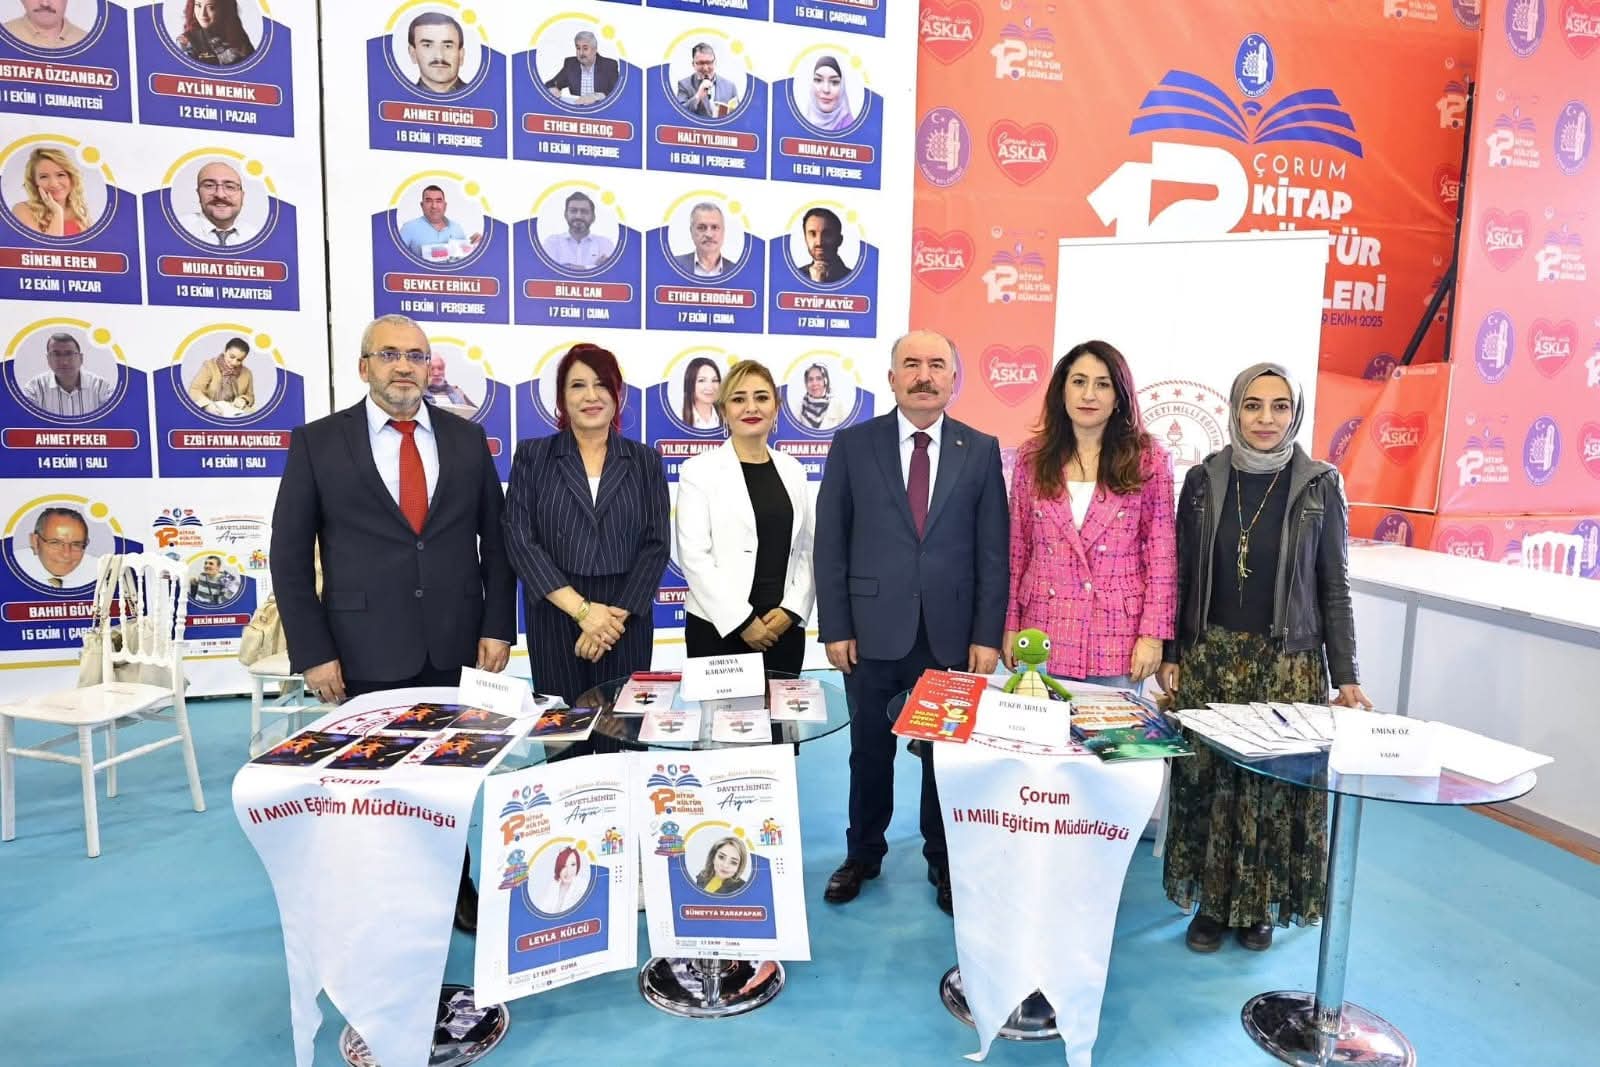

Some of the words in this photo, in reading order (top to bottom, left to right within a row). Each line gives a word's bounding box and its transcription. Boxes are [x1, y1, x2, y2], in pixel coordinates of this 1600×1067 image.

[808, 7, 823, 20] EKİM
[829, 12, 867, 26] ÇARŞAMBA
[990, 39, 1029, 80] 12
[46, 65, 112, 86] ÖZCANBAZ
[177, 79, 212, 95] AYLİN
[215, 82, 255, 100] MEMİK
[10, 88, 36, 104] EKİM
[45, 93, 103, 110] CUMARTESİ
[180, 106, 191, 118] 12
[193, 104, 217, 121] EKİM
[226, 109, 256, 123] PAZAR
[404, 107, 441, 122] AHMET
[441, 108, 474, 126] BİÇİCİ
[543, 119, 577, 133] ETHEM
[579, 122, 613, 138] ERKOÇ
[409, 129, 430, 144] EKİM
[438, 133, 482, 148] PERŞEMBE
[550, 140, 570, 155] EKİM
[577, 144, 619, 159] PERŞEMBE
[681, 151, 700, 165] EKİM
[706, 155, 745, 169] PERŞEMBE
[1253, 152, 1347, 180] ÇORUM
[803, 162, 820, 176] EKİM
[826, 166, 861, 180] PERŞEMBE
[1252, 177, 1353, 220] KİTAP
[22, 251, 63, 267] SİNEM
[64, 254, 96, 269] EREN
[183, 262, 222, 276] MURAT
[224, 261, 265, 277] GÜVEN
[20, 277, 32, 289] 12
[34, 276, 59, 291] EKİM
[69, 279, 101, 292] PAZAR
[177, 284, 188, 296] 13
[191, 282, 214, 298] EKİM
[222, 285, 272, 301] PAZARTESİ
[404, 279, 444, 293] ŞEVKET
[446, 278, 480, 293] ERİKLİ
[555, 282, 581, 297] BİLAL
[583, 287, 602, 298] CAN
[981, 265, 1019, 304] 12
[668, 291, 699, 303] ETHEM
[700, 291, 744, 305] ERDOĞAN
[794, 295, 821, 309] EYYÜP
[823, 297, 853, 310] AKYÜZ
[413, 299, 434, 313] EKİM
[441, 303, 485, 316] PERŞEMBE
[549, 307, 558, 317] 17
[560, 305, 579, 318] EKİM
[587, 309, 609, 320] CUMA
[678, 312, 688, 322] 17
[689, 310, 707, 323] EKİM
[713, 314, 734, 324] CUMA
[798, 317, 807, 327] 17
[808, 316, 825, 329] EKİM
[830, 318, 849, 329] CUMA
[1330, 311, 1358, 327] EKİM
[1360, 314, 1384, 328] 2025
[1173, 405, 1200, 417] MİLLİ
[35, 434, 71, 446] AHMET
[73, 434, 107, 446] PEKER
[183, 431, 206, 446] EZGİ
[207, 434, 238, 446] FATMA
[240, 432, 282, 448] AÇIKGÖZ
[38, 457, 51, 468] 14
[53, 454, 77, 469] EKİM
[85, 457, 107, 468] SALI
[201, 457, 214, 468] 14
[215, 454, 238, 469] EKİM
[246, 457, 266, 468] SALI
[29, 601, 68, 617] BAHRİ
[22, 629, 34, 640] 15
[35, 626, 61, 640] EKİM
[320, 775, 380, 787] Çorum
[1019, 785, 1070, 806] Çorum
[248, 806, 262, 825] İl
[263, 795, 303, 823] Milli
[304, 796, 346, 817] Eğitim
[351, 797, 456, 829] Müdürlüğü
[953, 807, 964, 823] İl
[968, 809, 999, 826] Milli
[1002, 811, 1049, 834] Eğitim
[1054, 818, 1129, 841] Müdürlüğü
[719, 909, 762, 918] KARAPAPAK
[528, 935, 557, 946] LEYLA
[560, 922, 590, 939] KÜLCÜ
